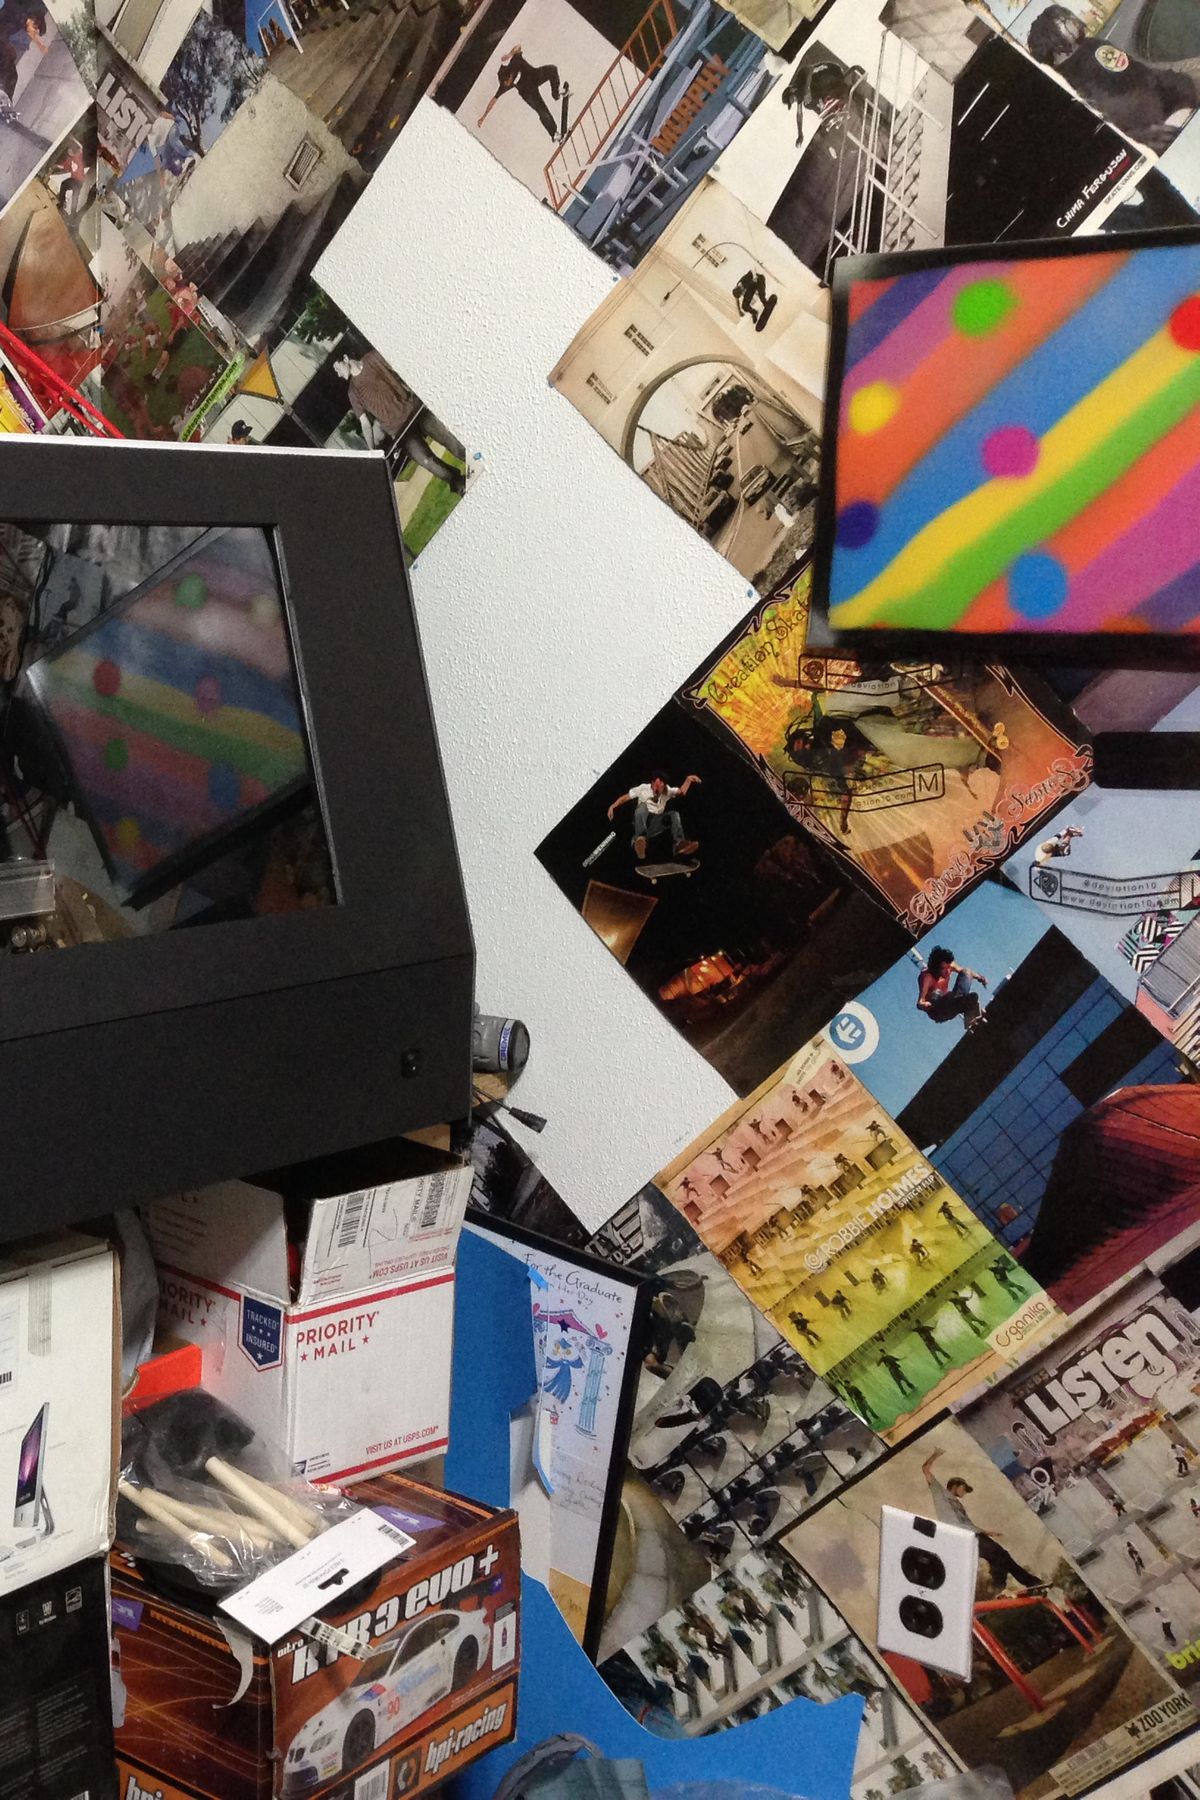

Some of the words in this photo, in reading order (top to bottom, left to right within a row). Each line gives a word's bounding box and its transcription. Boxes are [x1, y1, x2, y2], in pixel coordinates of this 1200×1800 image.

[650, 54, 731, 156] MURPHY
[820, 1212, 871, 1259] ROBBIE
[866, 1163, 930, 1219] HOLMES
[565, 1270, 623, 1304] Graduate
[297, 1312, 377, 1348] PRIORITY
[313, 1338, 357, 1361] MAIL
[365, 1443, 382, 1455] VISIT
[383, 1439, 393, 1450] US
[393, 1436, 403, 1447] AT
[1138, 1710, 1164, 1732] ZOO
[1160, 1692, 1193, 1718] YORK
